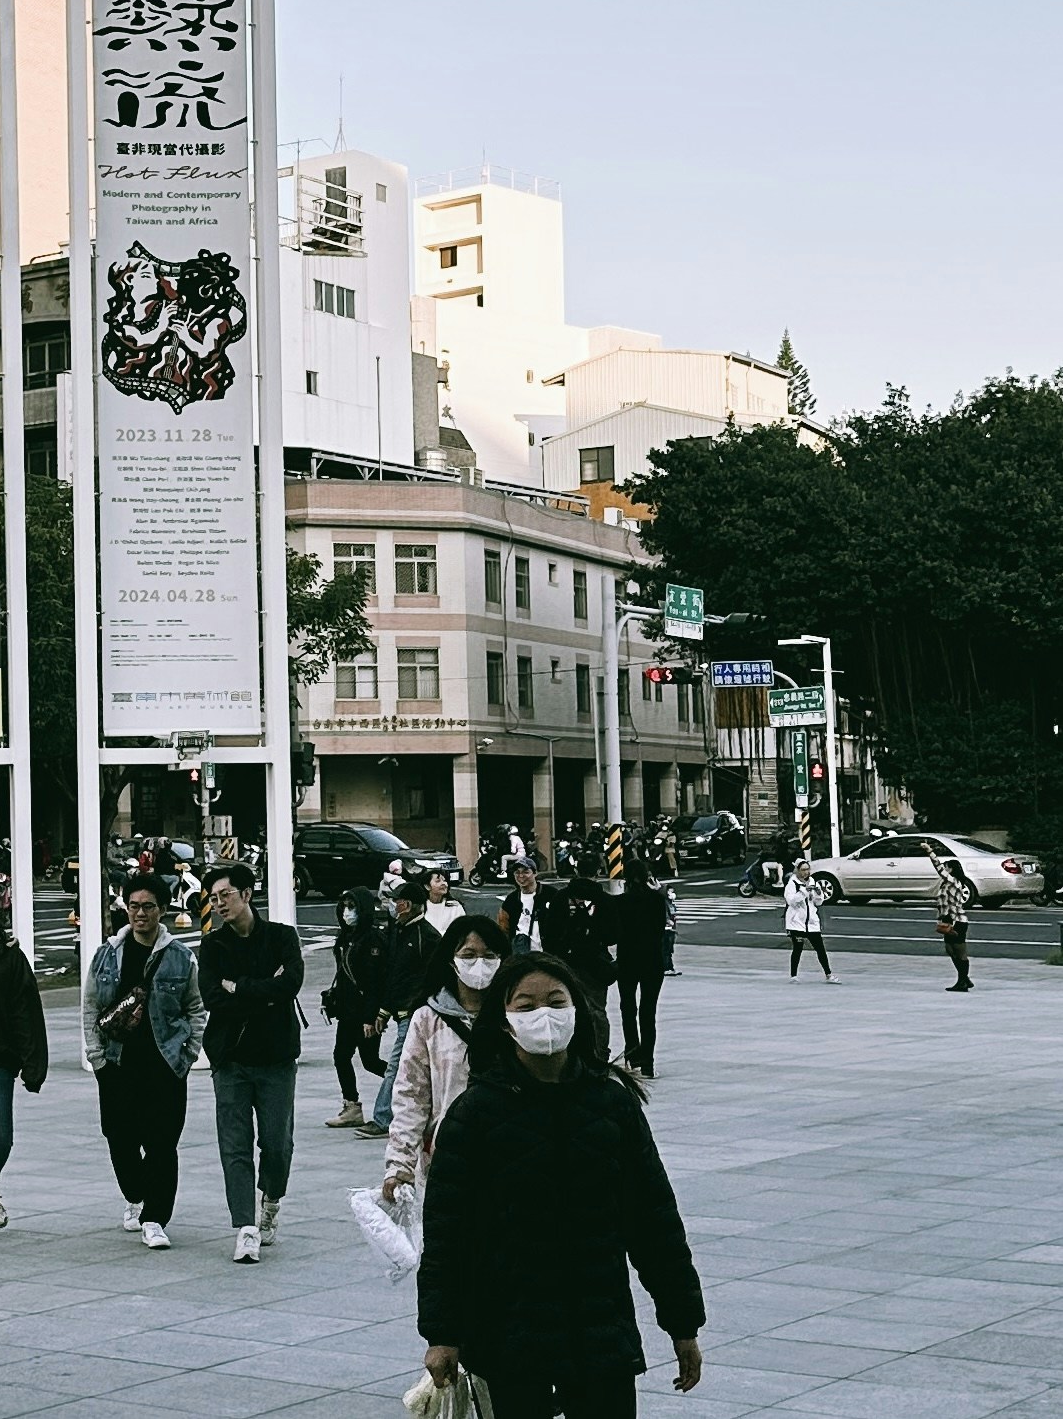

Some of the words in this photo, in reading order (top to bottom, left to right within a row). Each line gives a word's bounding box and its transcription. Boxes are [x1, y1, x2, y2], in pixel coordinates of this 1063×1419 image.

[116, 142, 226, 156] 臺非現當代攝影
[98, 165, 160, 179] Hot
[163, 165, 249, 180] Flux
[102, 190, 140, 199] Modern
[144, 190, 163, 199] and
[167, 191, 241, 200] Contemporary
[132, 204, 198, 213] Photography
[201, 204, 211, 212] in
[125, 217, 163, 225] Taiwan
[166, 217, 185, 225] and
[188, 217, 218, 225] Africa
[115, 429, 212, 442] 2023.11.28
[217, 433, 234, 442] Tue
[118, 589, 216, 603] 2024.04.28
